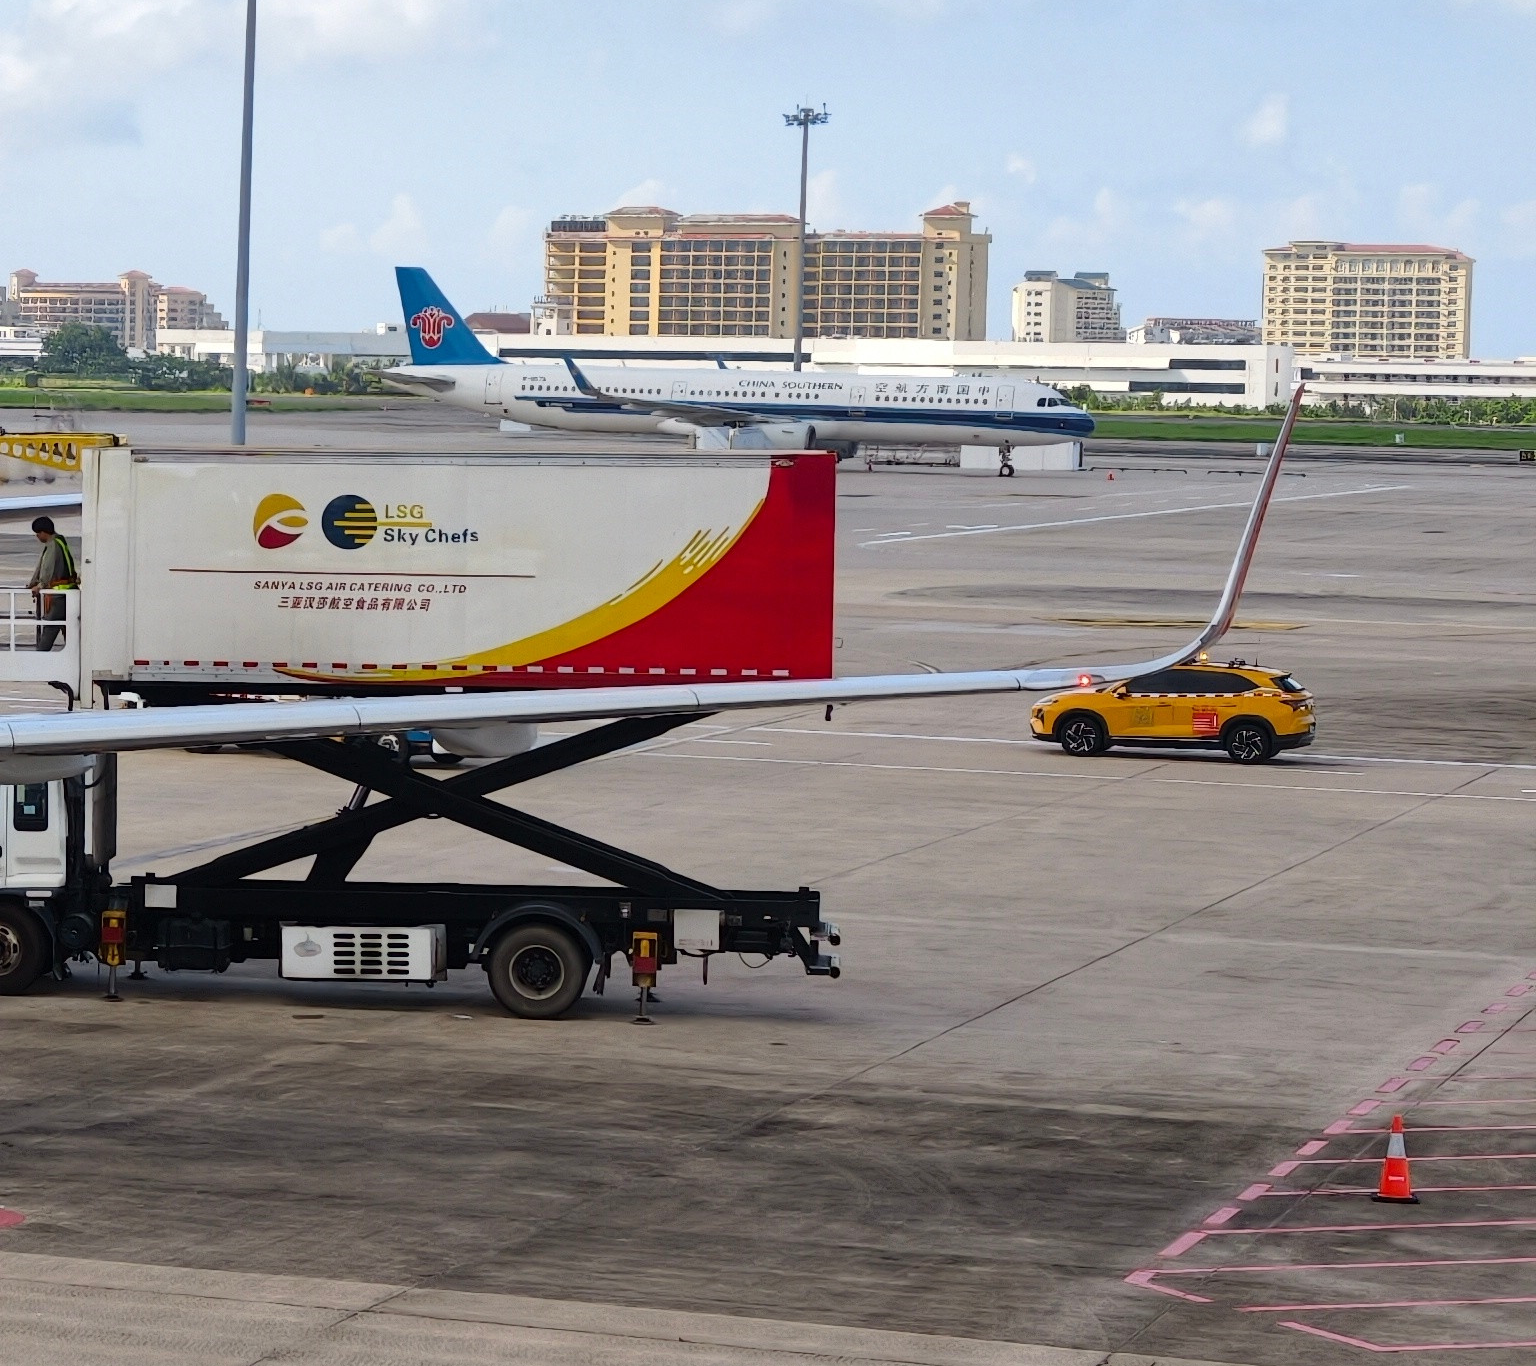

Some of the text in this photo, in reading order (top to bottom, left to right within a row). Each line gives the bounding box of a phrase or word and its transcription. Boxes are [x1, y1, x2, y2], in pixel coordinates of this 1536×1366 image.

[739, 380, 843, 390] CHINA SOUTHERN
[385, 504, 424, 519] LSG
[383, 528, 479, 546] Sky Chefs
[254, 580, 296, 590] SANYA
[299, 581, 323, 590] LSG
[326, 582, 346, 591] AIR
[349, 582, 413, 593] CATERING
[278, 596, 432, 612] 三亚汉莎航空食品有限公司
